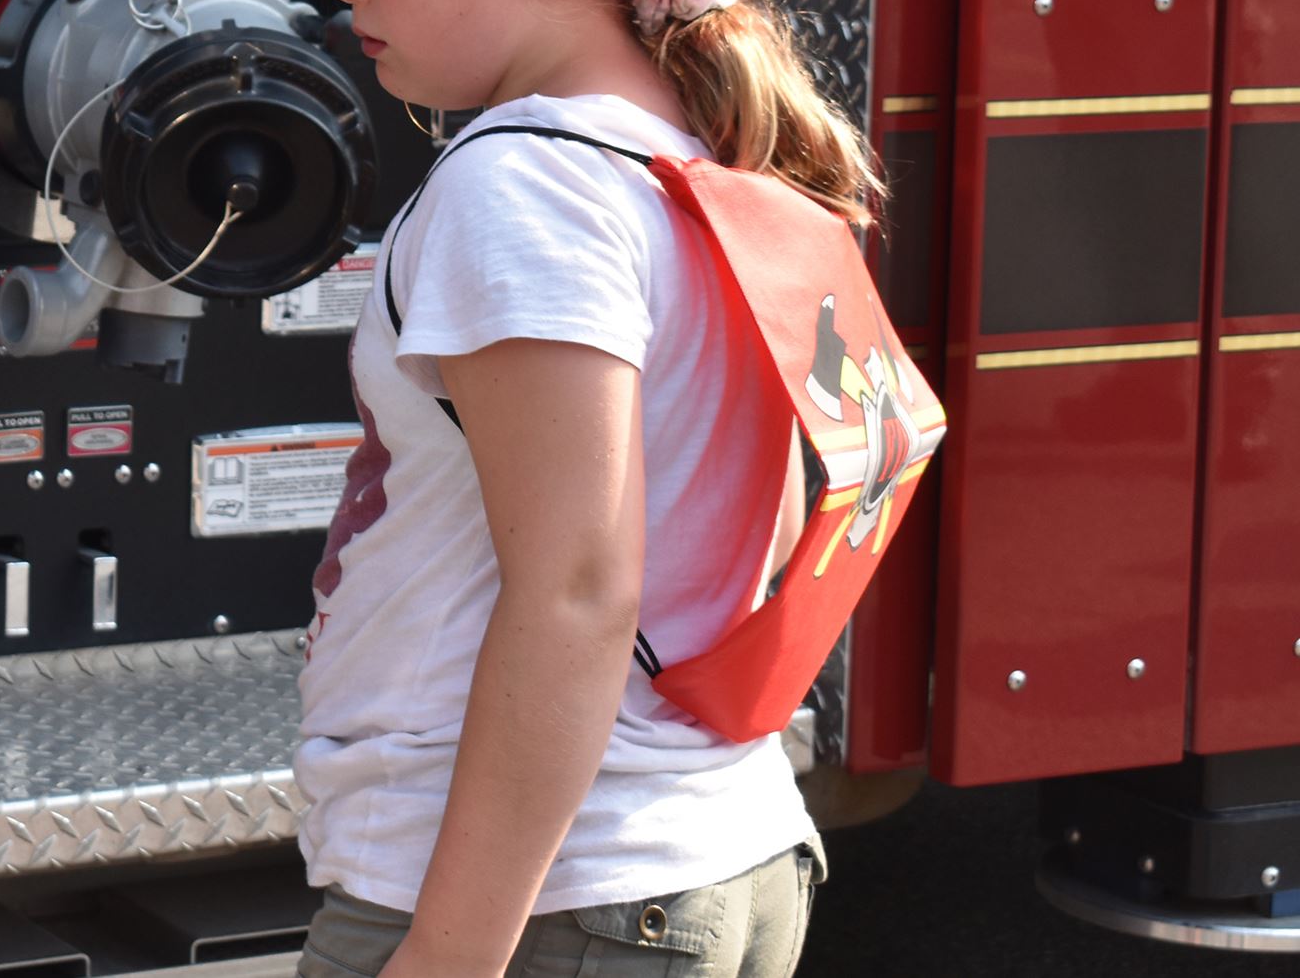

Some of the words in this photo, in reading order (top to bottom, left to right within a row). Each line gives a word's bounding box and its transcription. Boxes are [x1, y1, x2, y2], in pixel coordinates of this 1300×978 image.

[5, 418, 17, 426] TO
[17, 416, 41, 425] OPEN
[71, 413, 91, 422] PULL
[105, 410, 128, 419] OPEN
